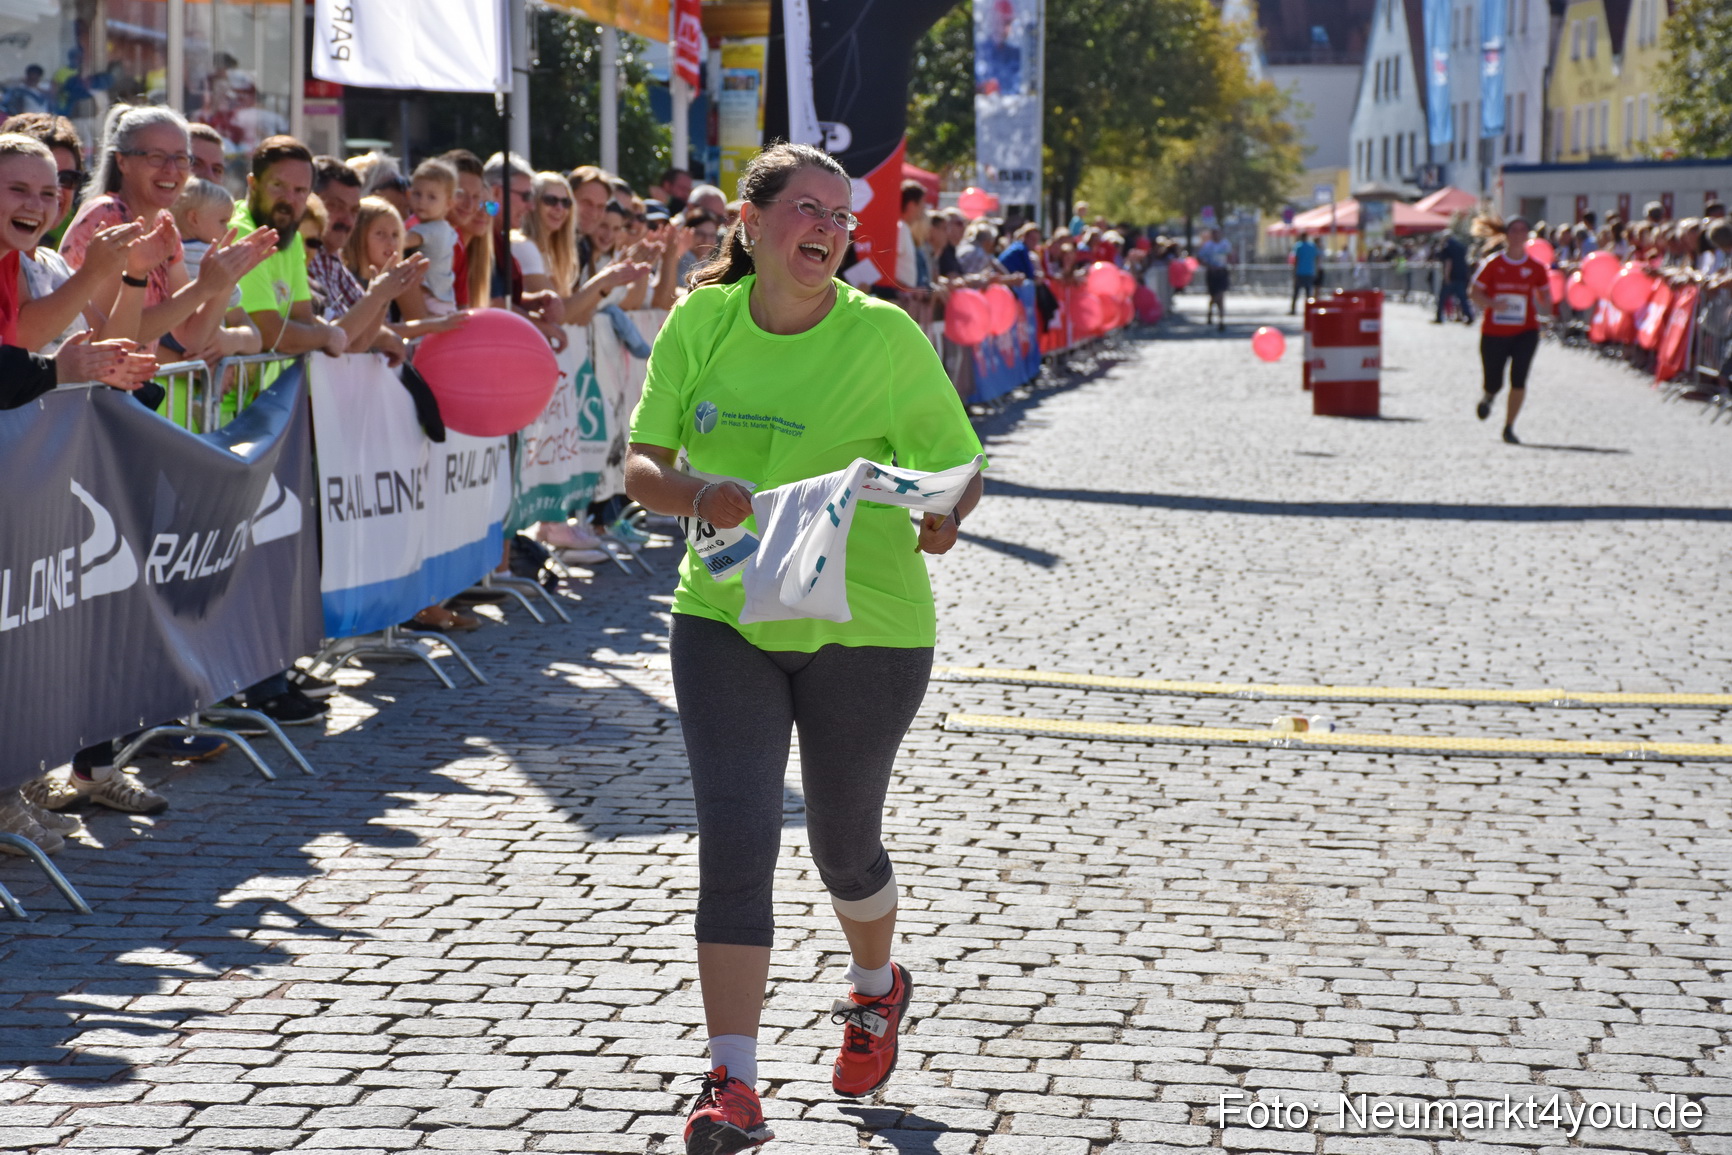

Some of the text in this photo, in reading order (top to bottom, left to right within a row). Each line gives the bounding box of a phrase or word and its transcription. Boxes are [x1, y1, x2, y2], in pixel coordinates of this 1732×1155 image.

[722, 411, 737, 419] Freie
[738, 412, 771, 422] katholisch
[728, 420, 741, 428] Haus
[705, 555, 734, 572] udia
[0, 546, 75, 632] L.ONE
